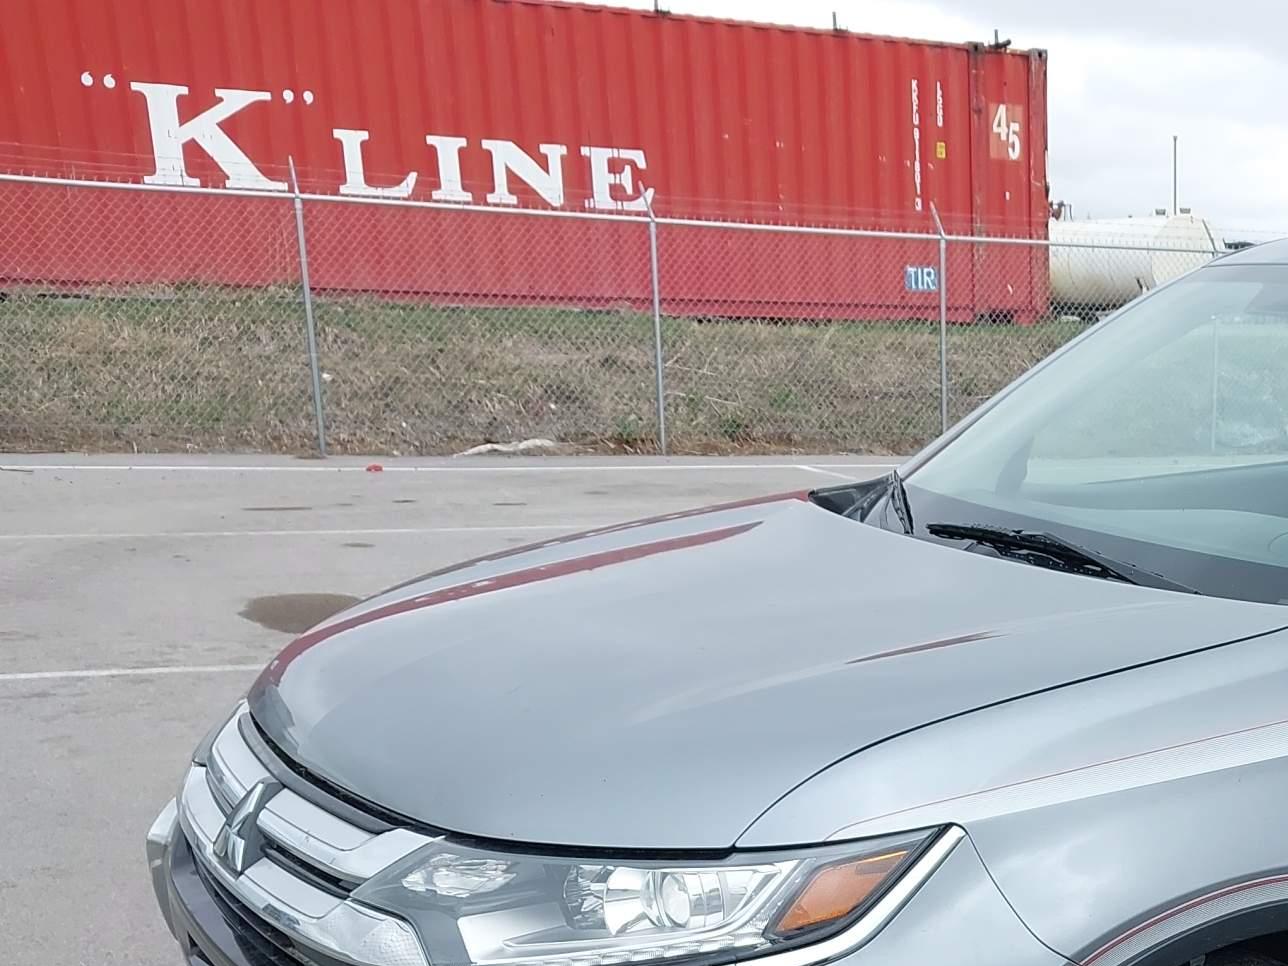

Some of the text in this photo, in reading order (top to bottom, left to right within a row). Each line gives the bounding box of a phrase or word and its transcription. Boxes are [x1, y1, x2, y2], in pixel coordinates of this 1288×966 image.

[992, 104, 1021, 160] 45
[333, 128, 655, 212] LINE
[908, 267, 936, 290] TIR
